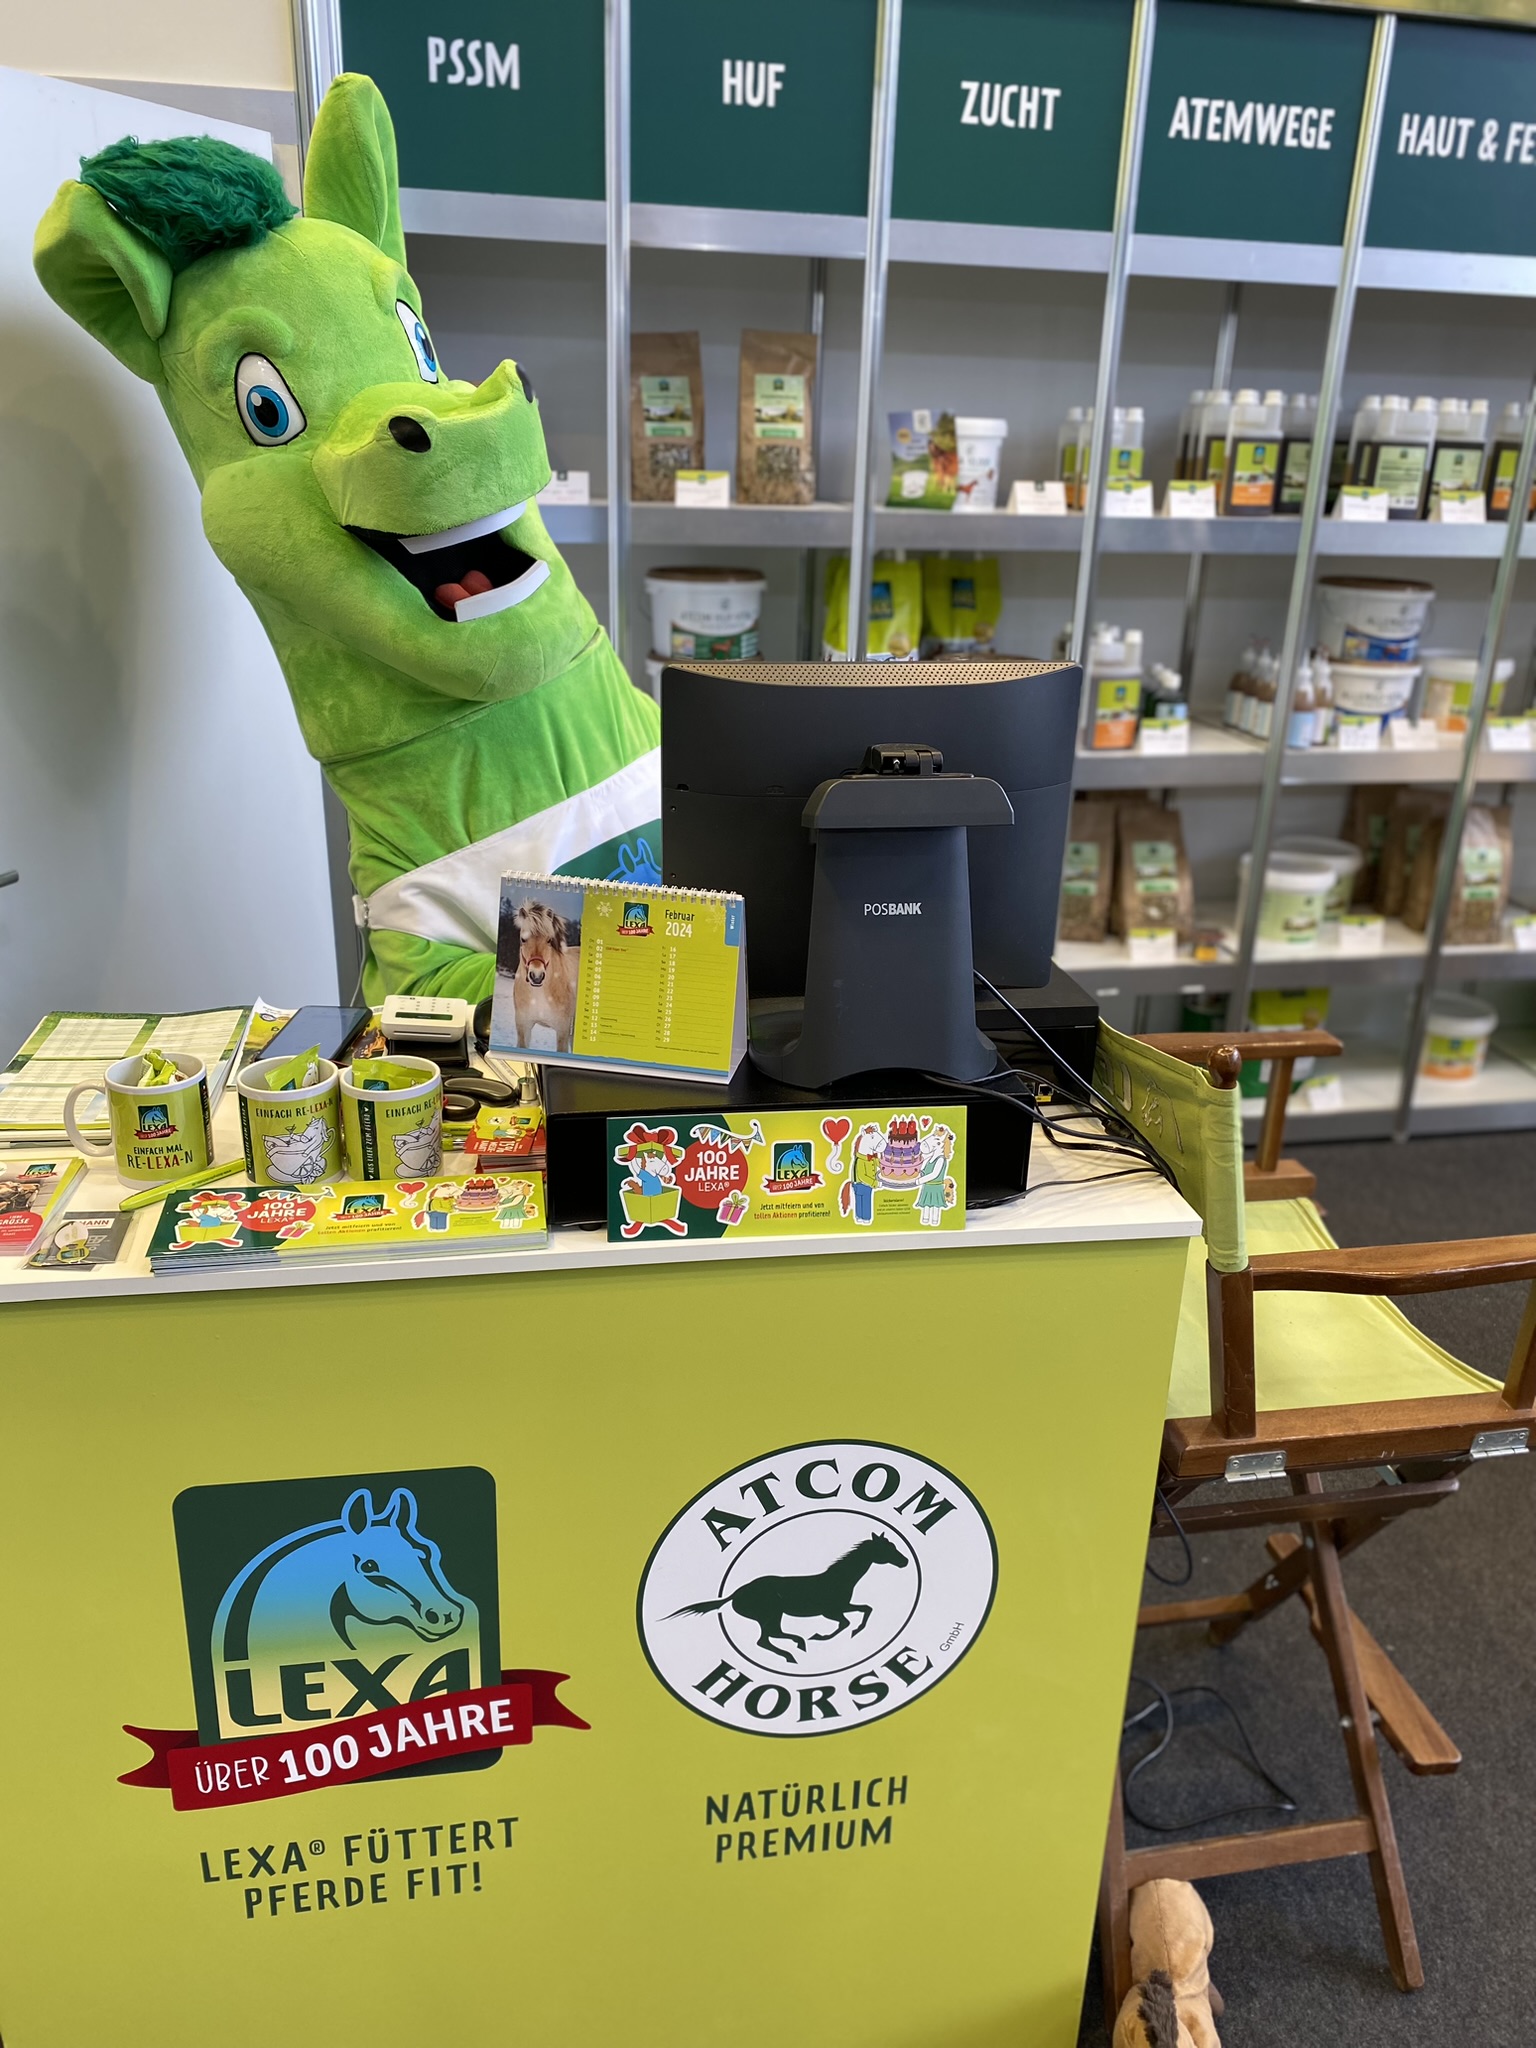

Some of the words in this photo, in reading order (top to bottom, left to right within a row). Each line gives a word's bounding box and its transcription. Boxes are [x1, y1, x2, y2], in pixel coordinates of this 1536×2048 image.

[428, 37, 520, 90] PSSM
[722, 59, 786, 108] HUF
[960, 80, 1061, 131] ZUCHT
[1168, 96, 1335, 150] ATEMWEGE
[1397, 113, 1476, 159] HAUT
[1477, 118, 1499, 161] &
[1504, 122, 1536, 164] FE
[664, 909, 695, 922] Februar
[864, 902, 922, 916] POSBANK
[665, 921, 693, 938] 2024
[255, 1108, 292, 1118] EINFACH
[295, 1098, 334, 1117] RE-LEXA-N
[385, 1104, 422, 1118] EINFACH
[133, 1146, 164, 1155] EINFACH
[166, 1143, 184, 1153] MAL
[696, 1150, 727, 1166] 100
[126, 1150, 194, 1170] RE-LEXA-N
[684, 1164, 740, 1182] JAHRE
[778, 1170, 808, 1180] LEXA
[698, 1181, 730, 1192] LEXA®
[782, 1182, 794, 1190] 100
[794, 1178, 814, 1186] JAHRE
[246, 1208, 307, 1219] JAHRE
[262, 1202, 295, 1211] 100
[798, 1210, 830, 1219] profitieren!
[699, 1457, 958, 1552] ATCOM
[938, 1620, 966, 1654] GmbH
[224, 1647, 472, 1728] LEXA
[691, 1644, 934, 1723] HORSE
[193, 1755, 270, 1795] ÜBER
[277, 1733, 360, 1785] 100
[368, 1697, 515, 1760] JAHRE
[704, 1774, 910, 1826] NATÜRLICH
[714, 1815, 894, 1864] PREMIUM
[199, 1838, 326, 1884] LEXA®
[343, 1816, 520, 1868] FÜTTERT
[243, 1871, 389, 1920] PFERDE
[406, 1860, 484, 1901] FIT!
